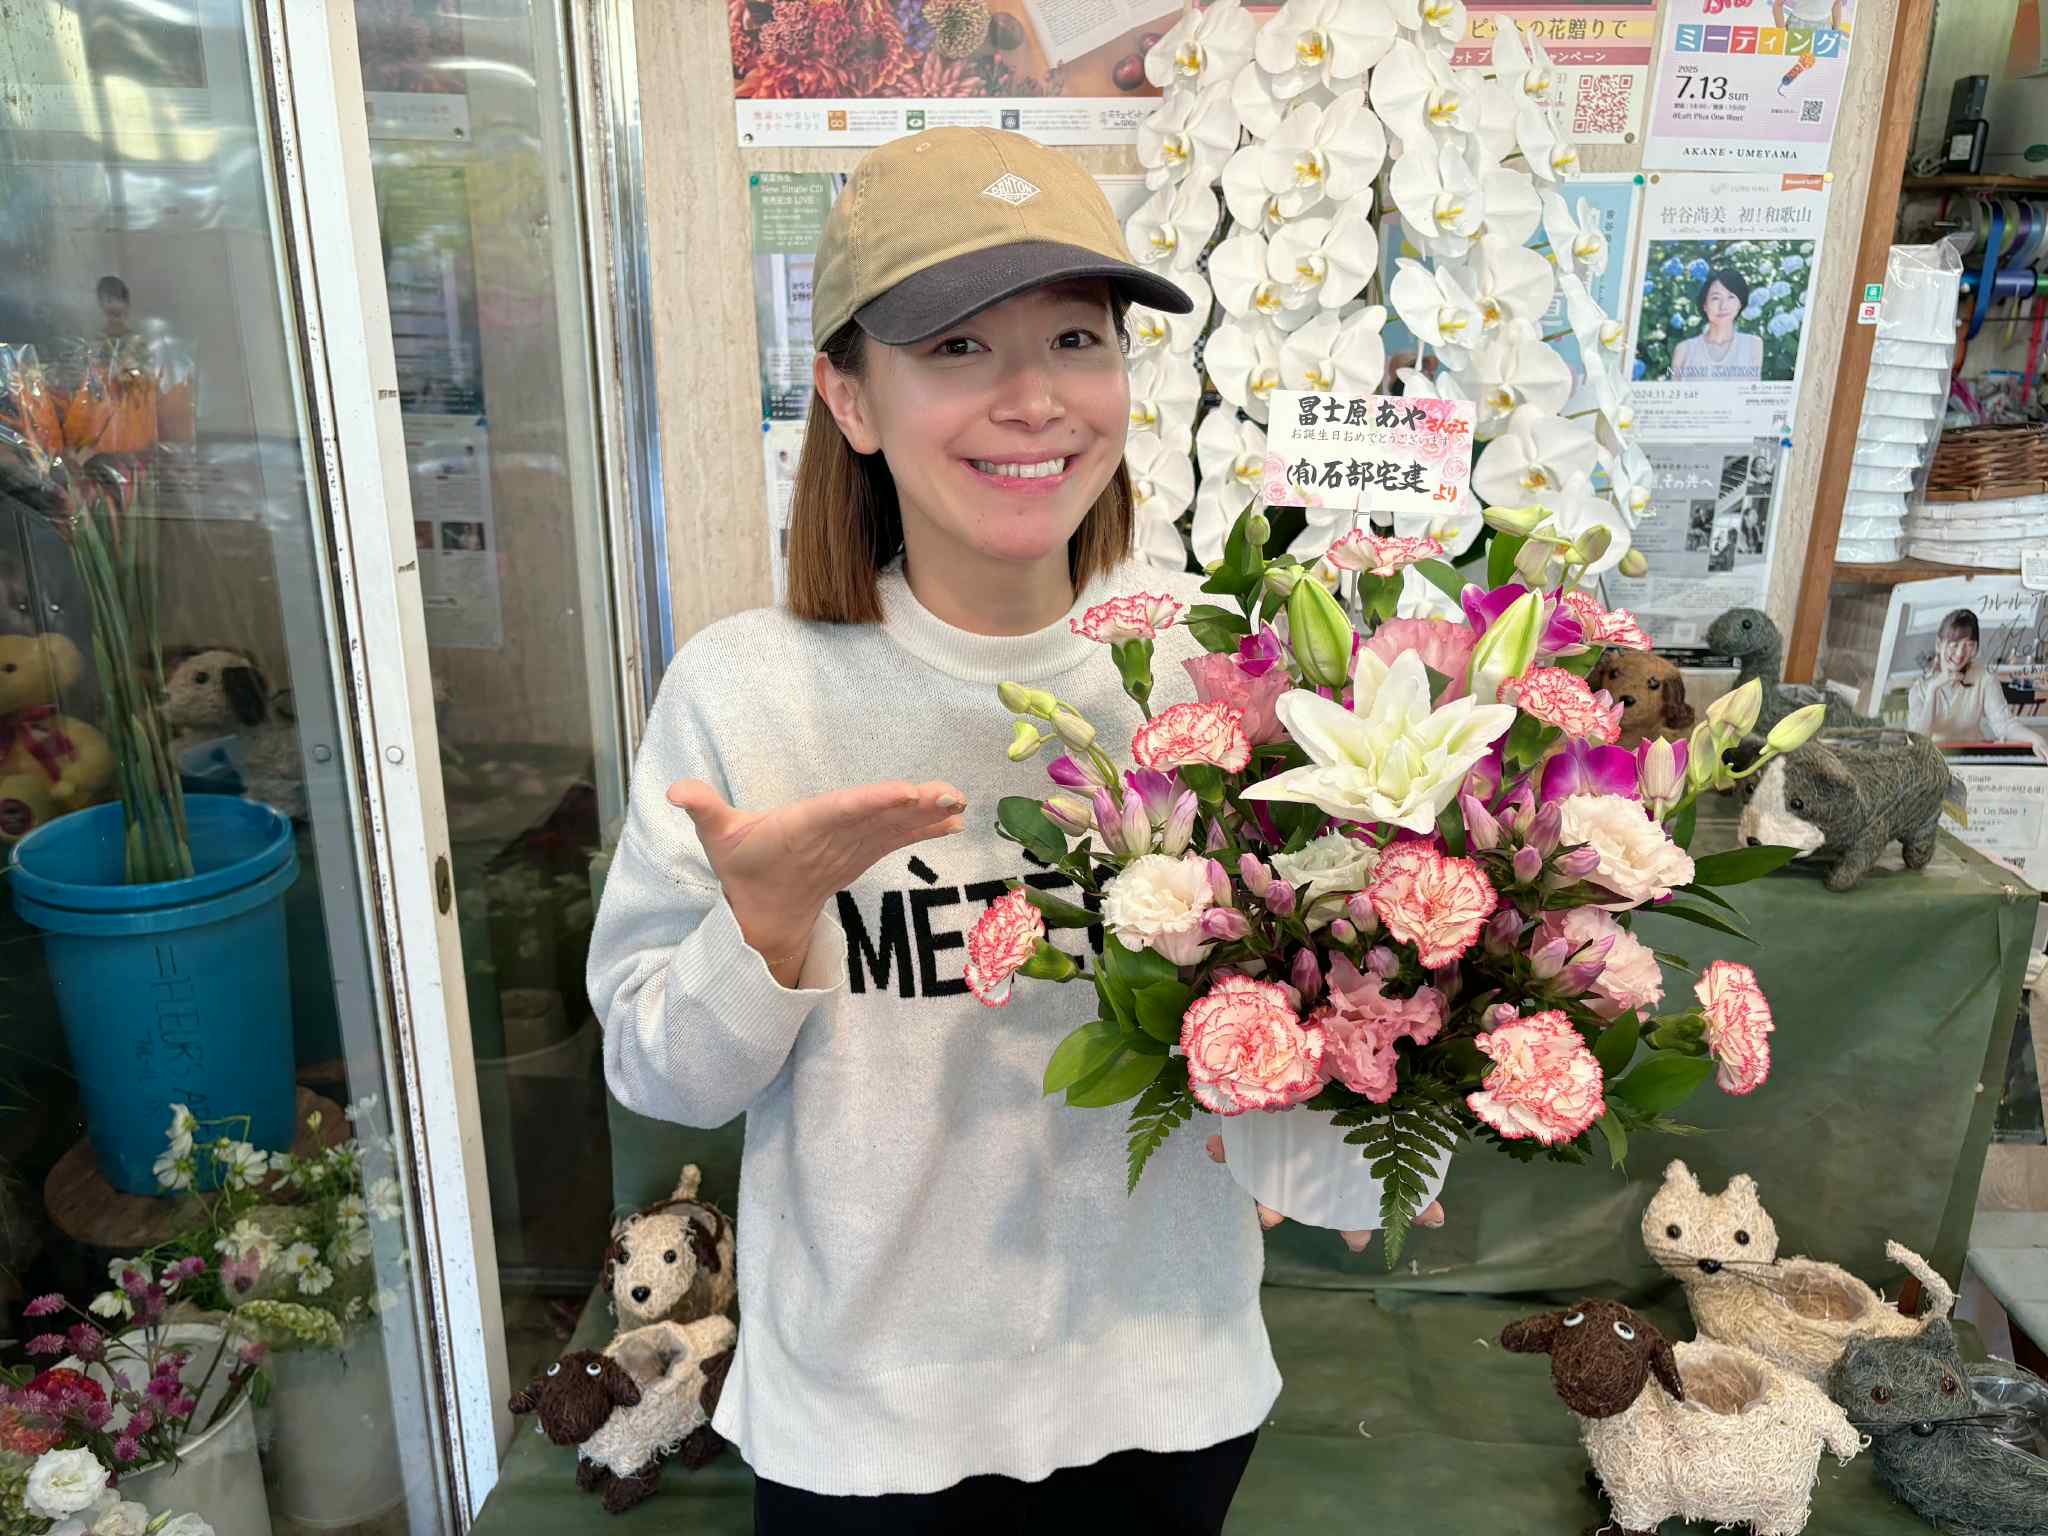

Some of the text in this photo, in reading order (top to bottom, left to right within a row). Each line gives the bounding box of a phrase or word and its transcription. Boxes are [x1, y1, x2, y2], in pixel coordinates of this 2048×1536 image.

[1678, 29, 1840, 55] ミーティング
[1677, 65, 1699, 74] 2025
[1675, 75, 1750, 101] 7.13 sun
[1682, 147, 1797, 159] AKANE UMEYAMA
[1632, 389, 1681, 400] 024.11.23
[1376, 400, 1427, 431] あや
[1433, 483, 1458, 501] より
